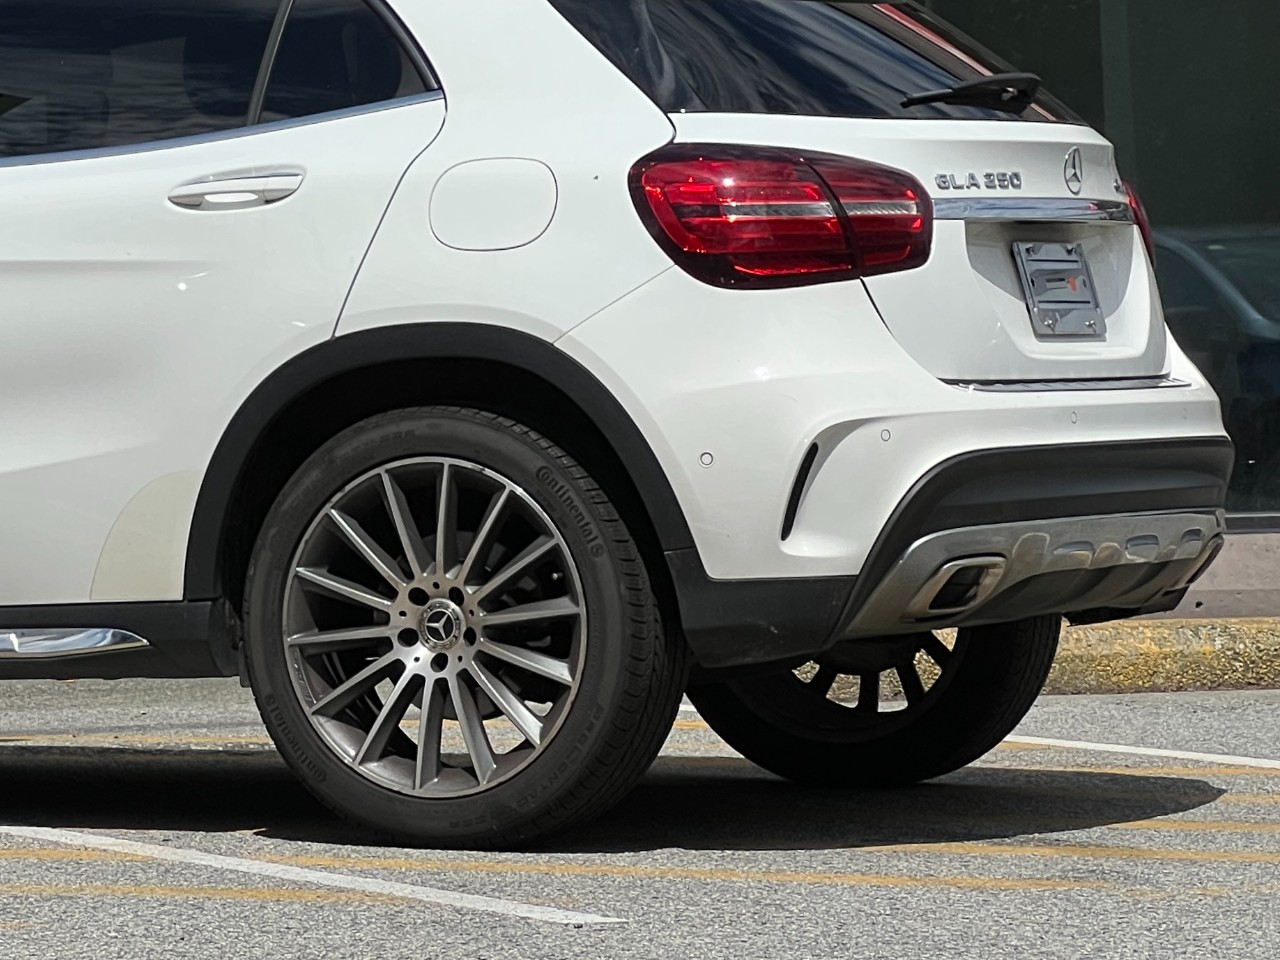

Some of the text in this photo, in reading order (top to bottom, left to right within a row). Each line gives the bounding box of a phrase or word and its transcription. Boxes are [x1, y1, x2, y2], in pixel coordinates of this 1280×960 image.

[934, 171, 1023, 191] GLA 250
[535, 465, 600, 545] Continental
[269, 705, 328, 784] Continental
